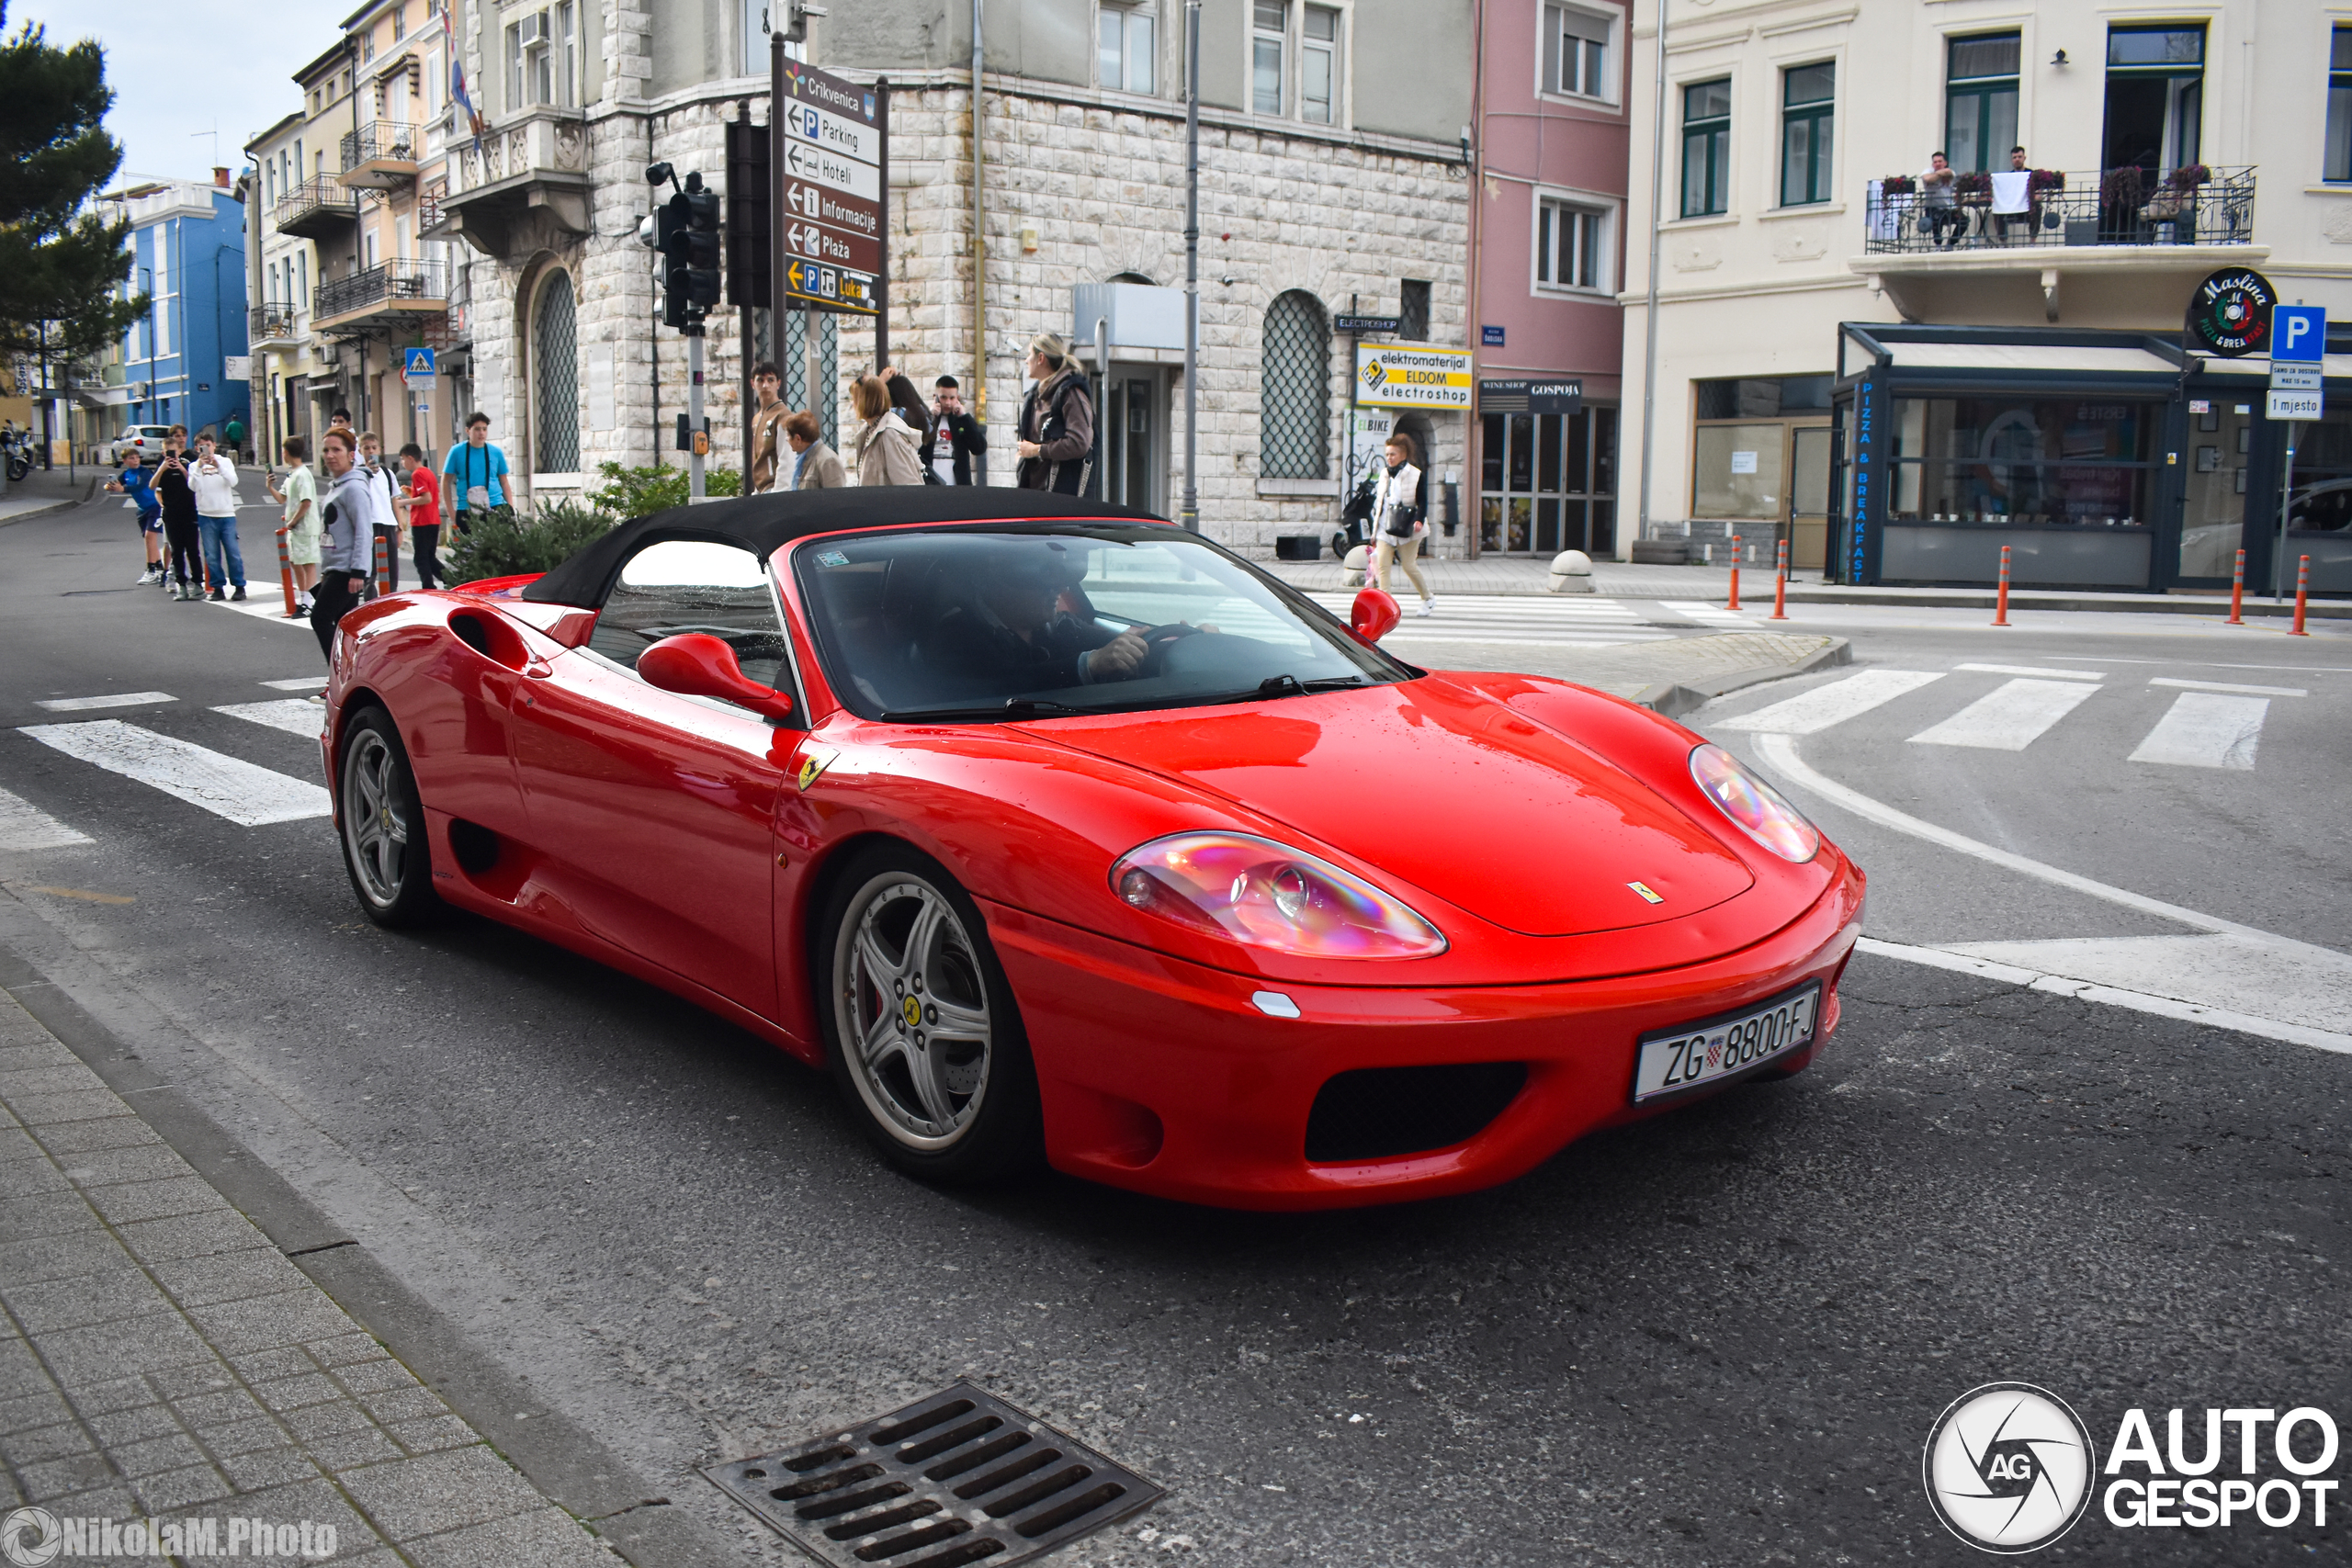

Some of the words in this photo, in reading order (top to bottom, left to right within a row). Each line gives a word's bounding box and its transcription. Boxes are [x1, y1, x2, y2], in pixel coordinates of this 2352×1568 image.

[808, 77, 859, 112] Crikvenica
[822, 119, 858, 152] Parking
[822, 159, 852, 185] Hoteli
[822, 197, 876, 231] Informacije
[822, 235, 850, 259] Plaža
[840, 276, 862, 299] Luka
[2204, 274, 2267, 307] Maslina
[2226, 291, 2243, 303] M
[1339, 318, 1397, 330] ELECTROSHOP
[2286, 315, 2310, 350] P
[1381, 353, 1466, 371] elektromaterijal
[1406, 369, 1447, 386] ELDOM
[1483, 381, 1505, 389] WINE
[1505, 381, 1528, 389] SHOP
[1382, 384, 1467, 405] electroshop
[1531, 384, 1579, 397] GOSPOJA
[1860, 382, 1872, 444] PIZZA
[2273, 398, 2277, 411] 1
[2280, 398, 2317, 414] mjesto
[1357, 419, 1389, 433] ELBIKE
[1859, 452, 1870, 463] &
[1853, 472, 1869, 583] BREAKFAST
[1663, 1034, 1706, 1087] ZG
